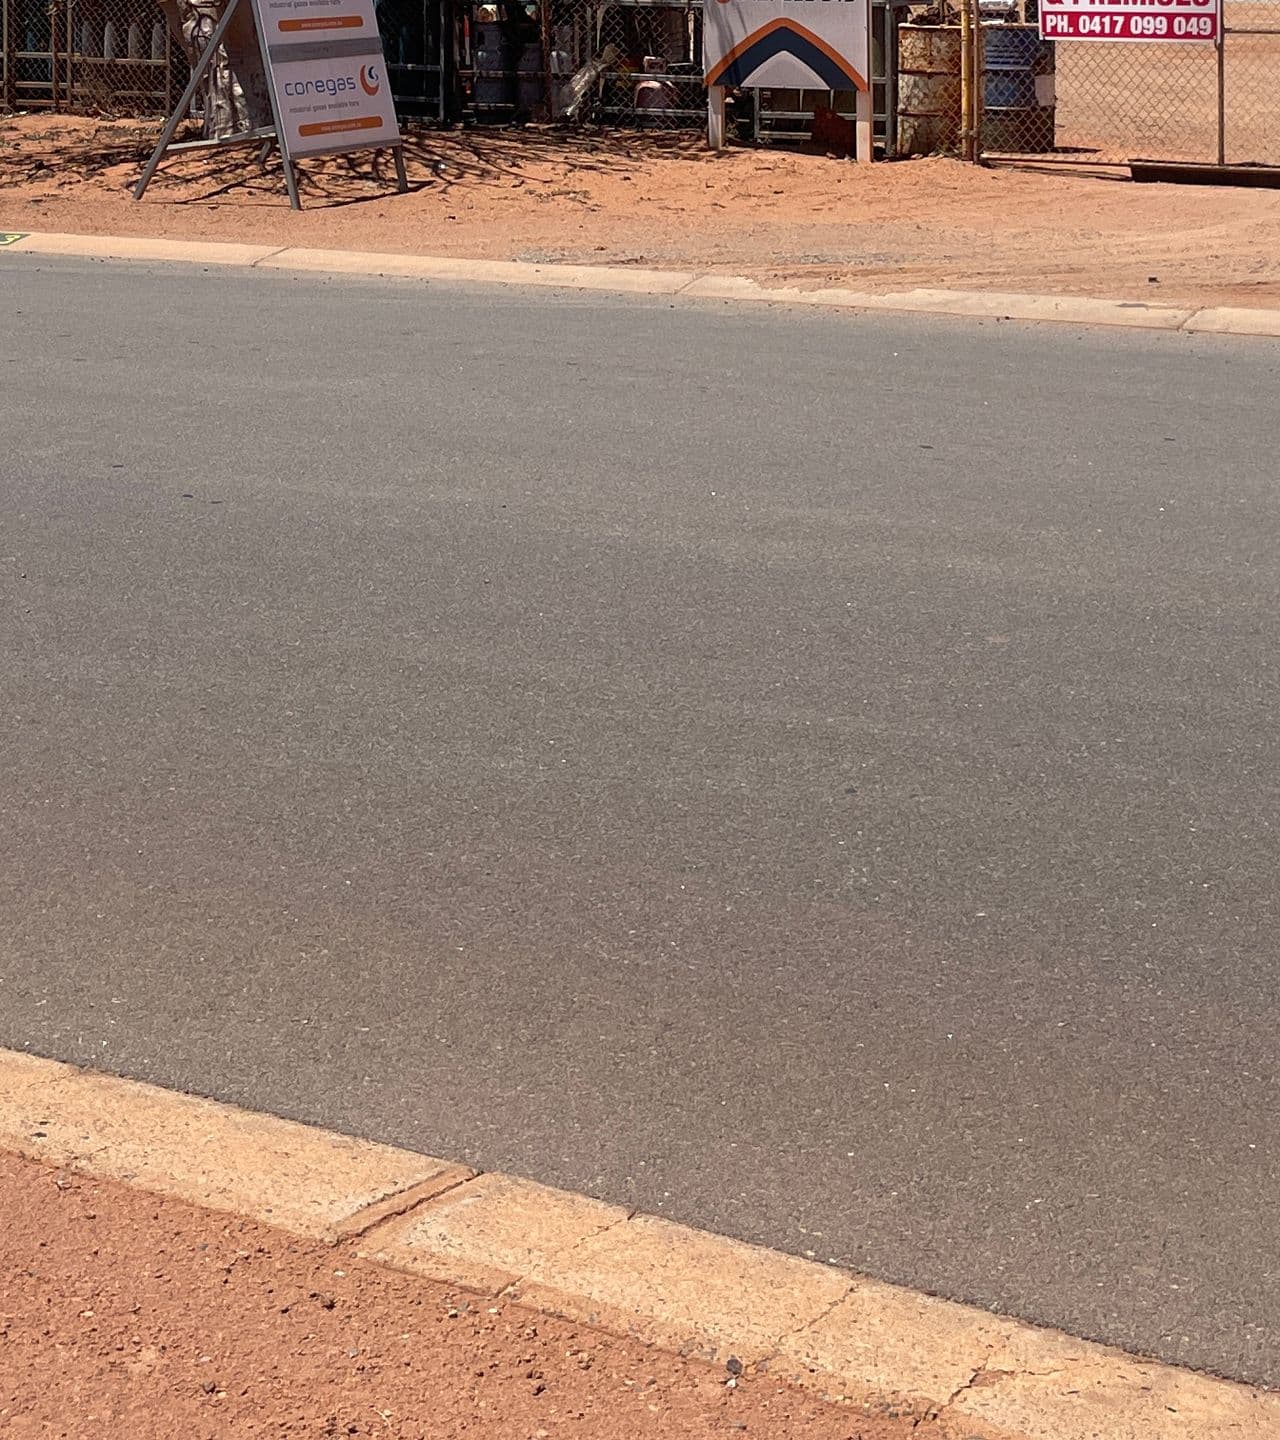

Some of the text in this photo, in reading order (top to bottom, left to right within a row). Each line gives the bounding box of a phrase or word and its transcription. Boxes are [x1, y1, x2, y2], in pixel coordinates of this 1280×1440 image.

[1046, 15, 1212, 35] PH. 0417 099 049
[284, 77, 356, 96] coregas
